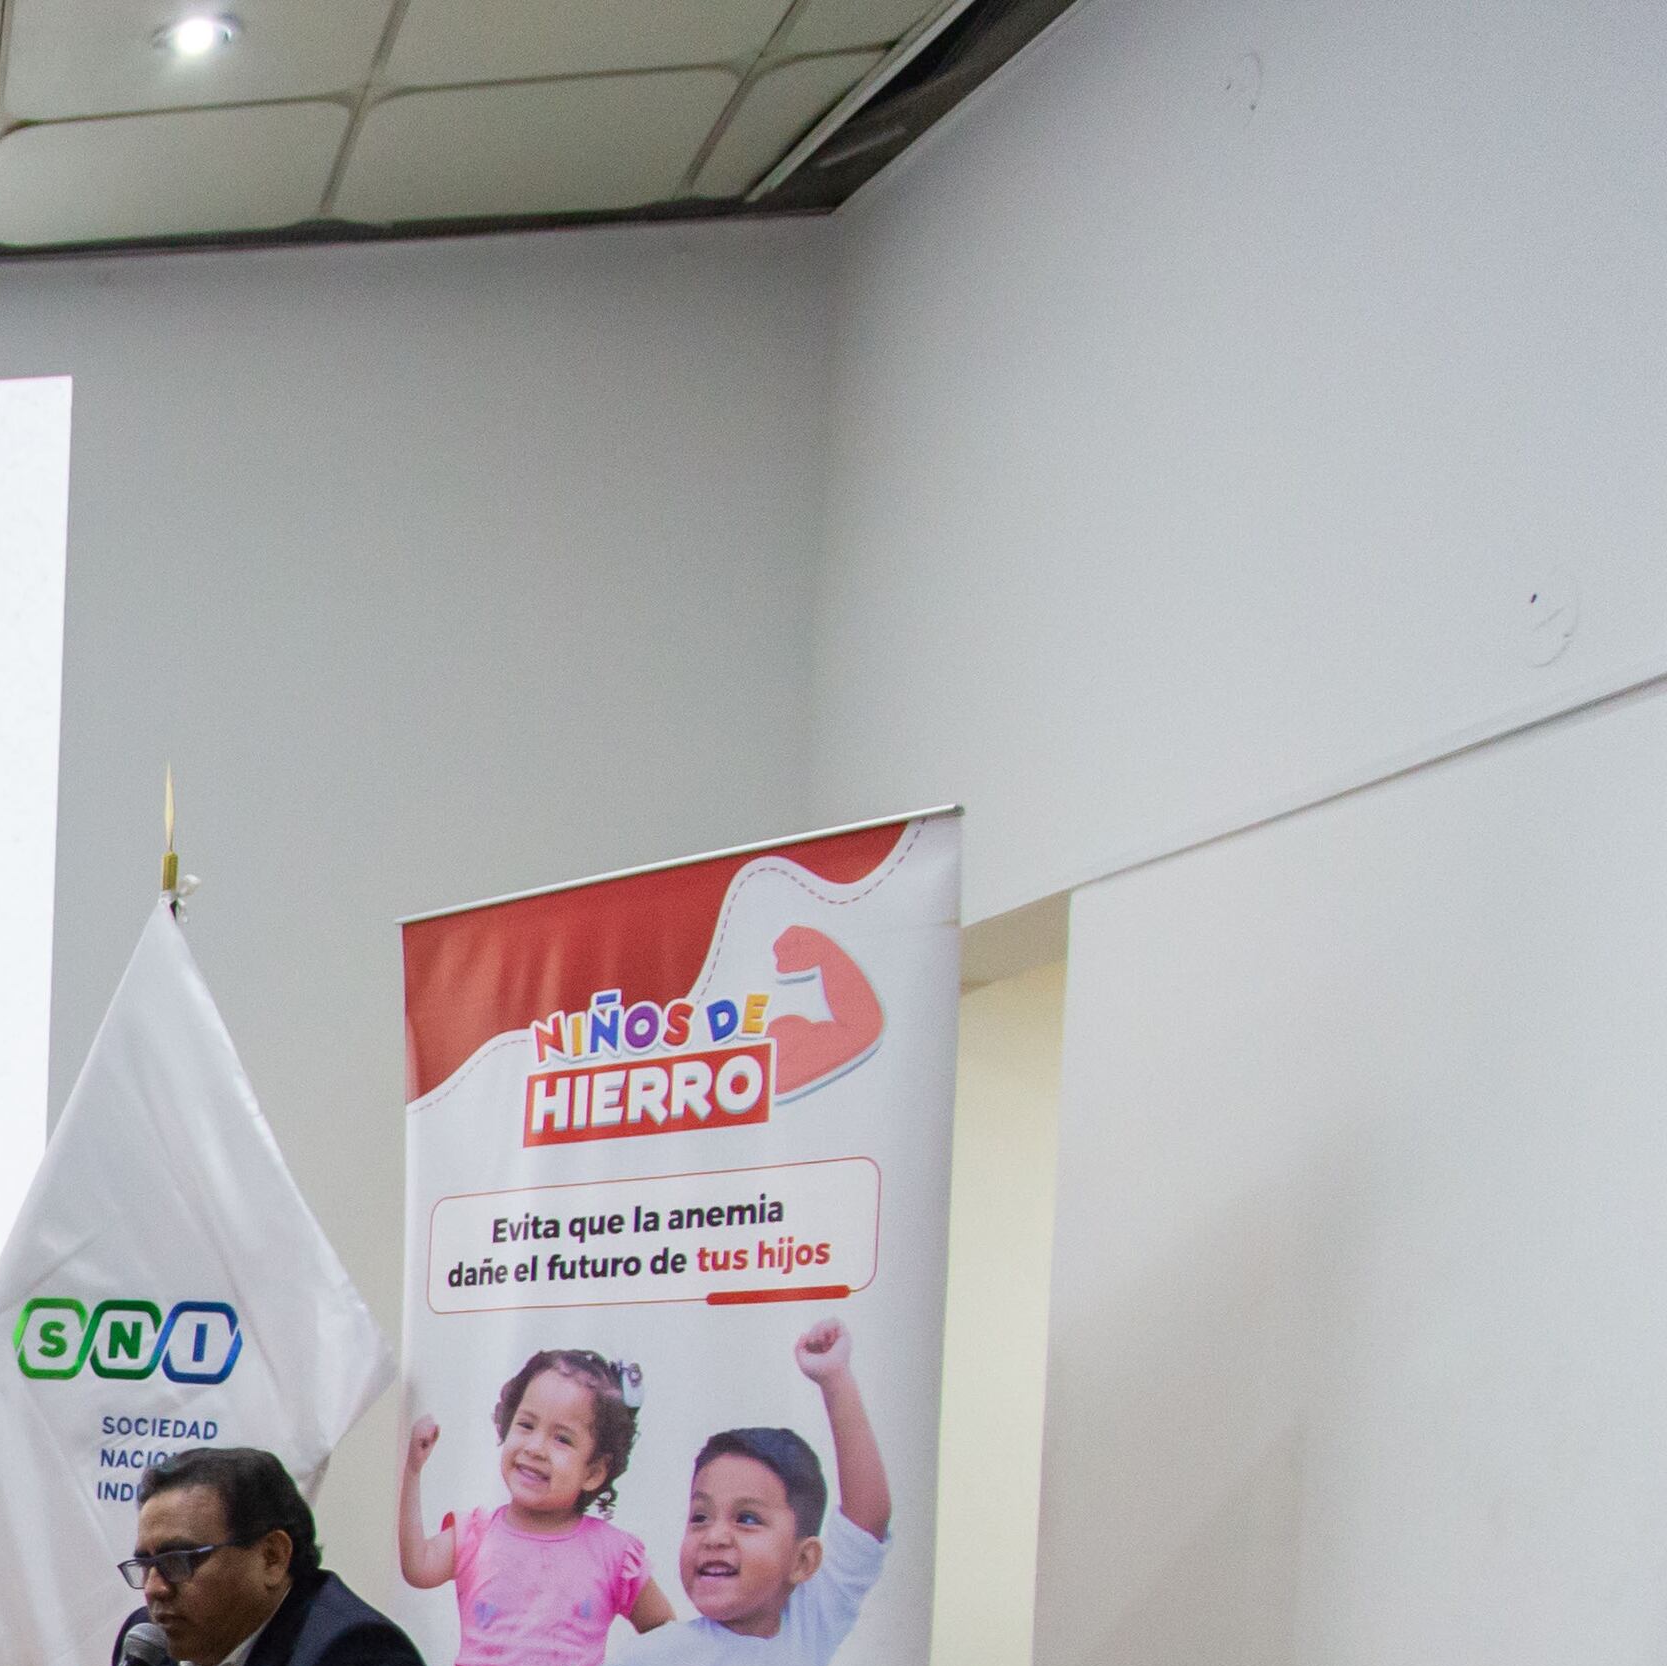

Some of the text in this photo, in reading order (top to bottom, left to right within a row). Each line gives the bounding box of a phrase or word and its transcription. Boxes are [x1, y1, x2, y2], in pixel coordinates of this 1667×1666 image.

[535, 989, 768, 1060] NIÑOS DE
[530, 1054, 763, 1135] HIERRO
[492, 1193, 783, 1243] Evita que la anemia
[448, 1237, 830, 1287] dañe el futuro de tus hijos
[103, 1416, 218, 1440] SOCIEDAD
